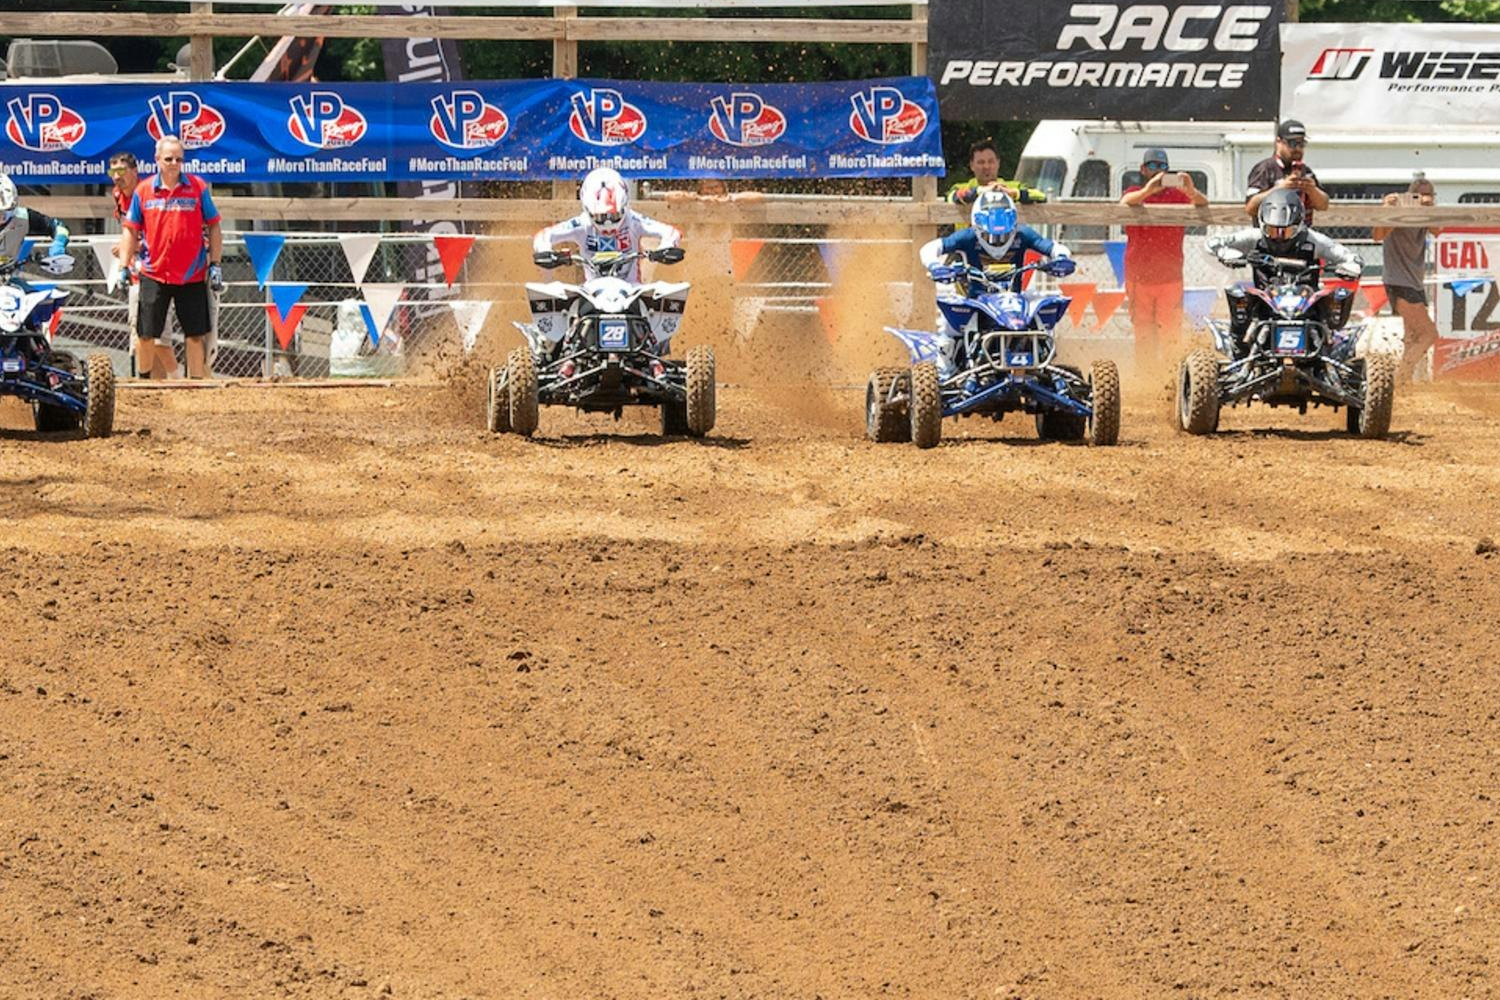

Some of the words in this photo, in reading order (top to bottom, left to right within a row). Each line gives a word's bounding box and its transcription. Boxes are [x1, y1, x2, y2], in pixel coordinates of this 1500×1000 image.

[1056, 4, 1272, 51] RACE
[940, 60, 1249, 88] PERFORMANCE
[1387, 82, 1486, 93] Performance
[7, 93, 62, 150] VP
[148, 91, 202, 146] VP
[289, 91, 344, 148] VP
[431, 90, 485, 148] VP
[571, 88, 623, 146] VP
[711, 92, 764, 146] VP
[850, 87, 904, 144] VP
[267, 157, 387, 172] #MoreThanRaceFuel
[408, 157, 528, 172] #MoreThanRaceFuel
[549, 155, 668, 171] #MoreThanRaceFuel
[688, 155, 807, 170] #MoreThanRaceFuel
[602, 325, 626, 341] 28
[1010, 354, 1029, 367] 4
